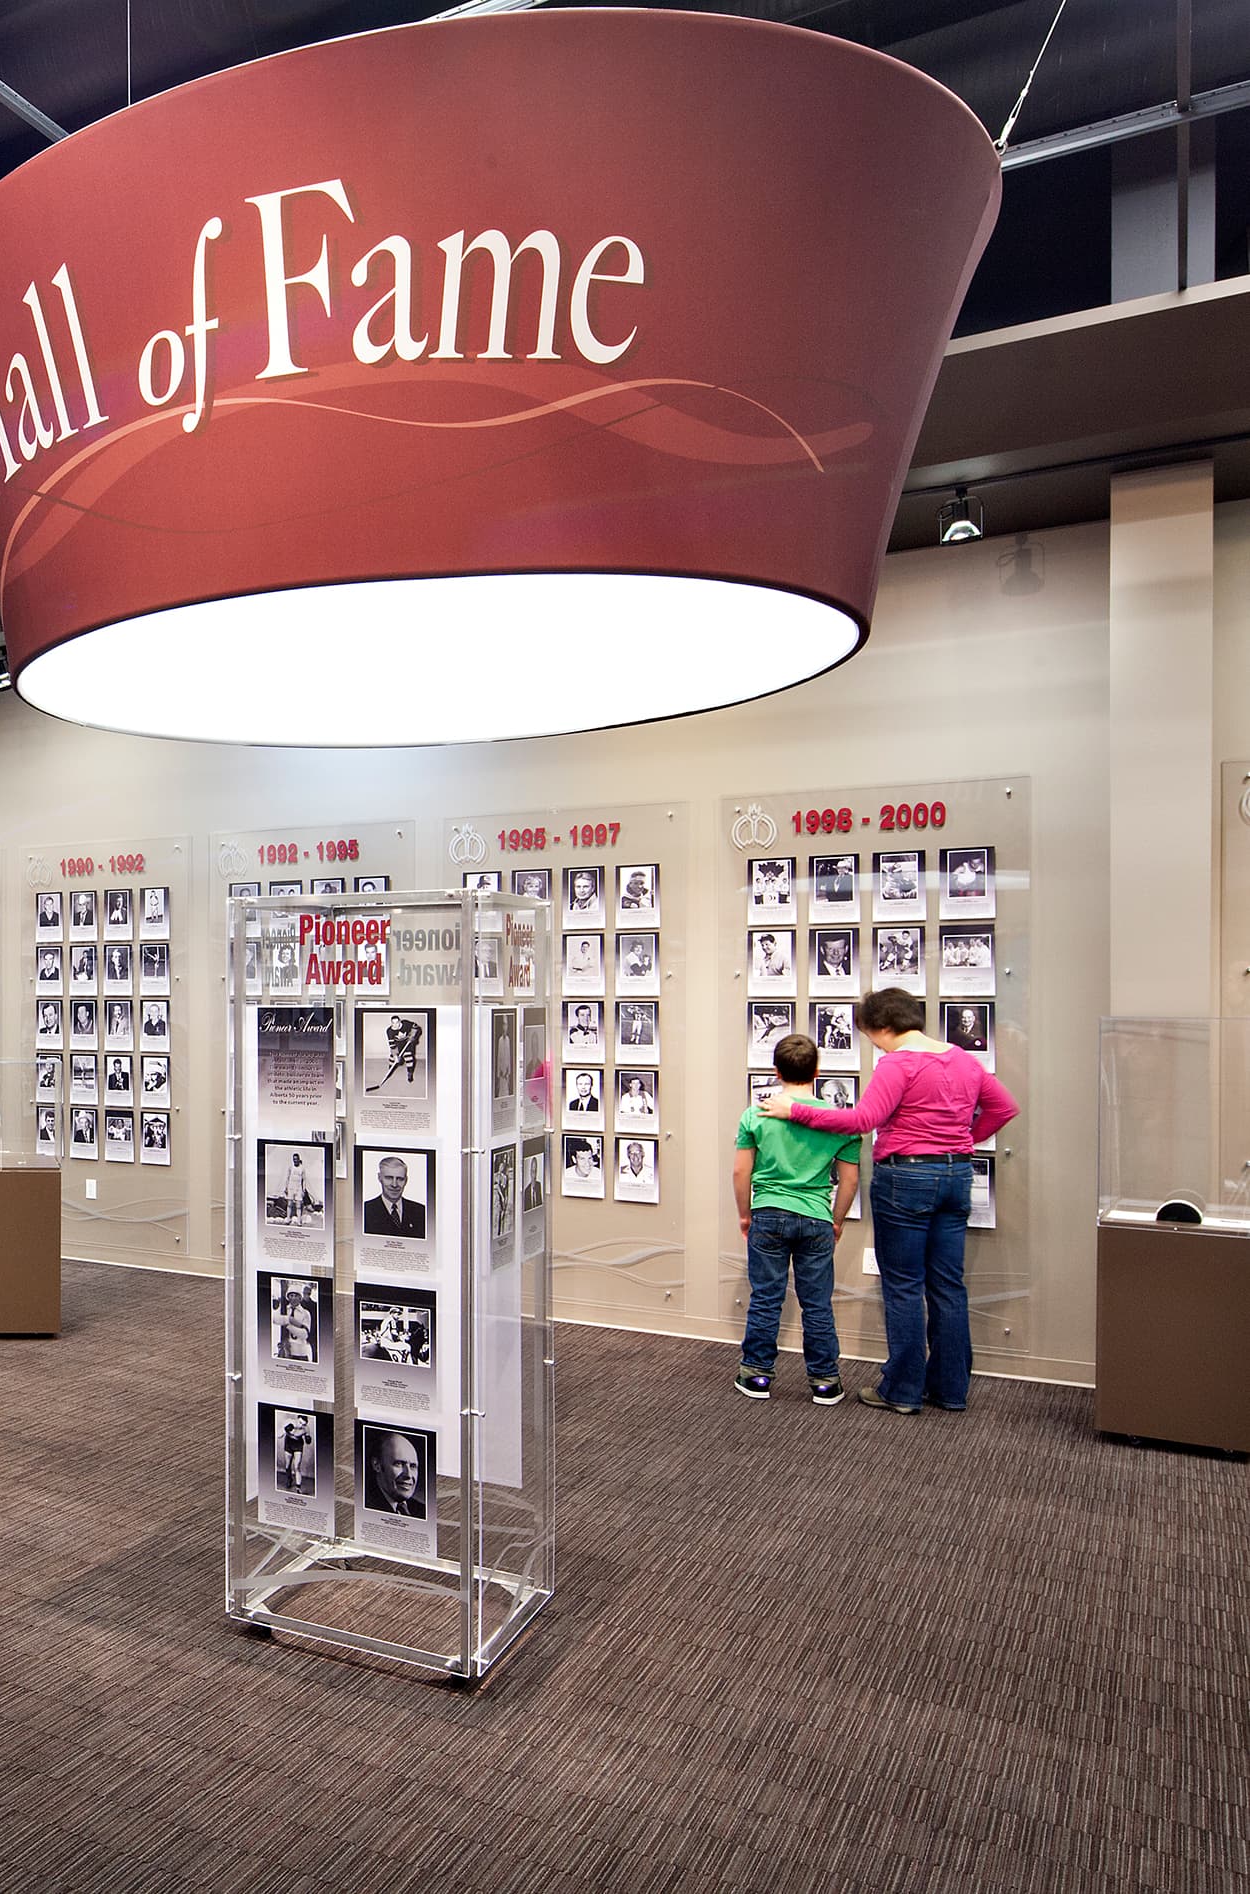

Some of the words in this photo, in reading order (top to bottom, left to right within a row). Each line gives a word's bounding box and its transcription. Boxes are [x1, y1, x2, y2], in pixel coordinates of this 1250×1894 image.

[138, 216, 221, 433] of
[244, 178, 645, 382] Fame
[792, 807, 853, 834] 1998
[879, 801, 946, 830] 2000
[498, 826, 546, 851] 1995
[569, 822, 620, 848] 1997
[60, 856, 94, 878] 1990
[109, 853, 145, 874] 1992
[258, 843, 298, 865] 1992
[316, 839, 359, 862] 1995
[300, 914, 392, 946] Pioneer
[305, 953, 383, 985] Award
[259, 1012, 293, 1033] Pioneer
[293, 1011, 333, 1033] Award
